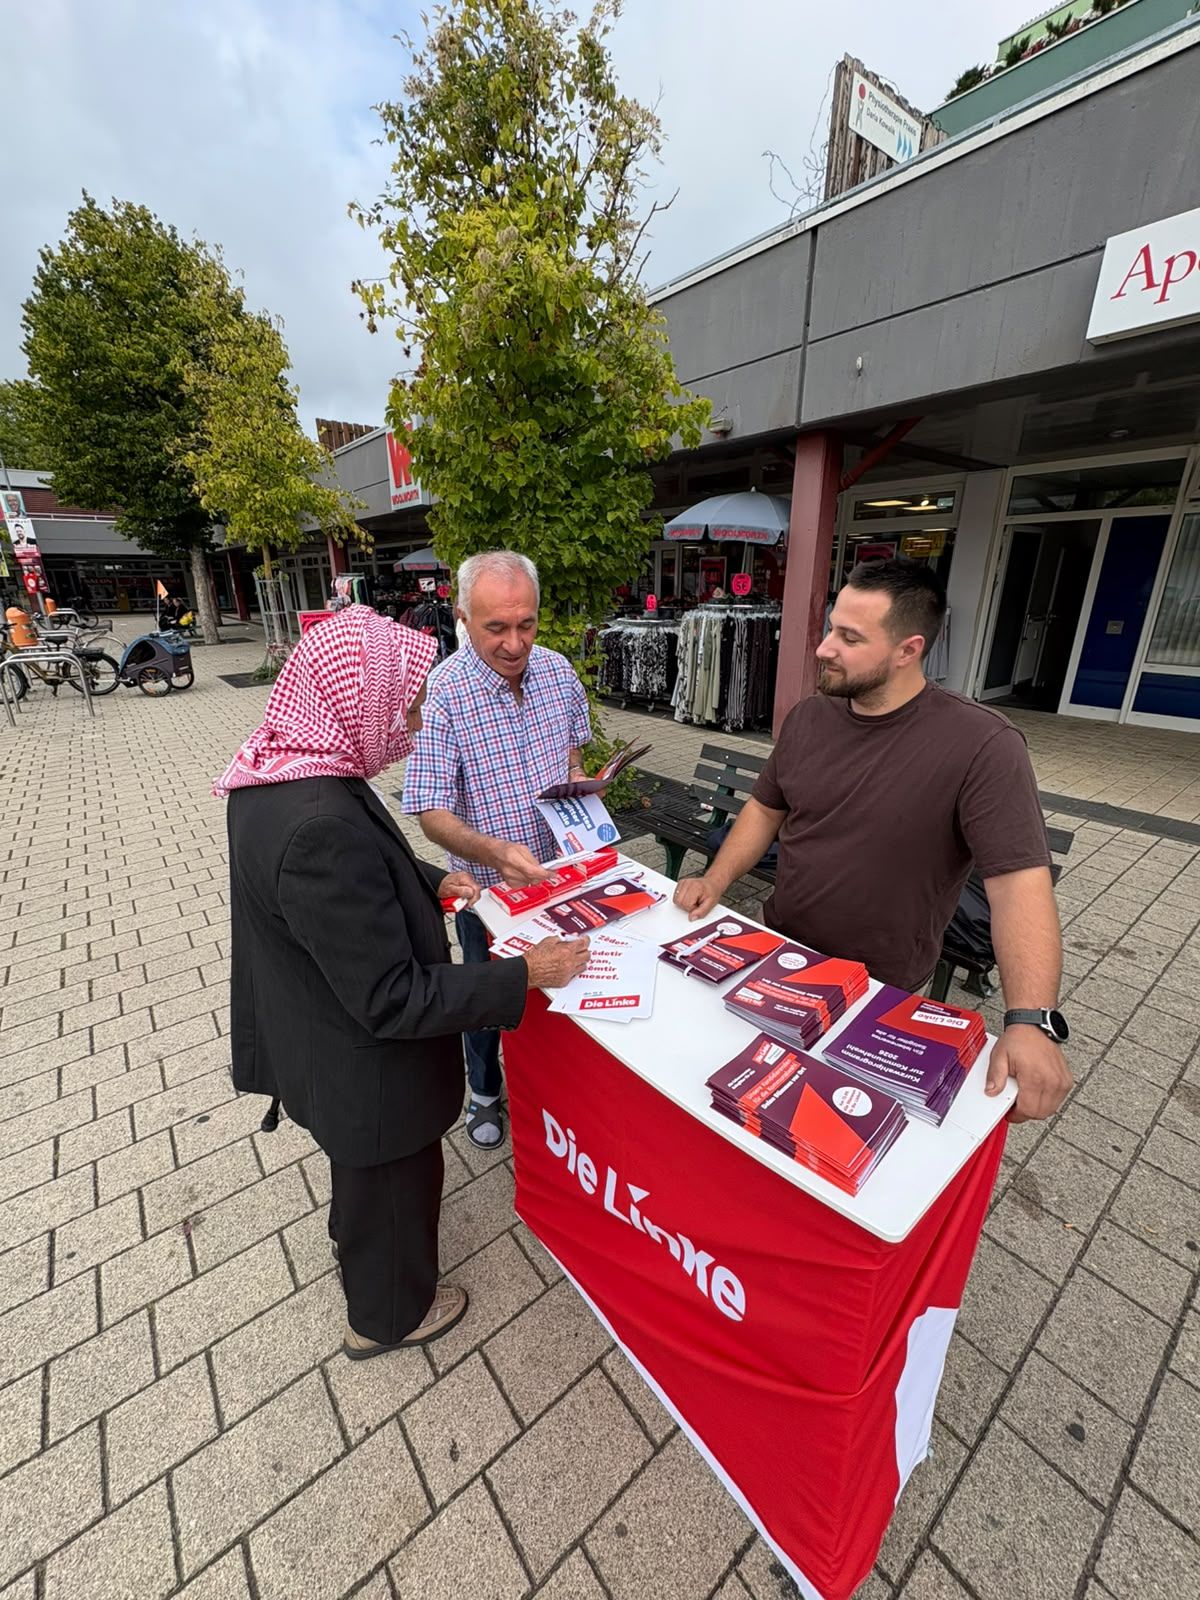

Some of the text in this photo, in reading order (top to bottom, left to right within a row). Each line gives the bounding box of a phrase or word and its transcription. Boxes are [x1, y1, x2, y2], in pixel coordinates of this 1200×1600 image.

[868, 91, 917, 137] Physiotherapie Praxis
[1110, 243, 1200, 304] Ap
[584, 998, 636, 1009] Die Linke
[878, 1049, 899, 1060] 2026
[541, 1108, 747, 1322] Die Linke
